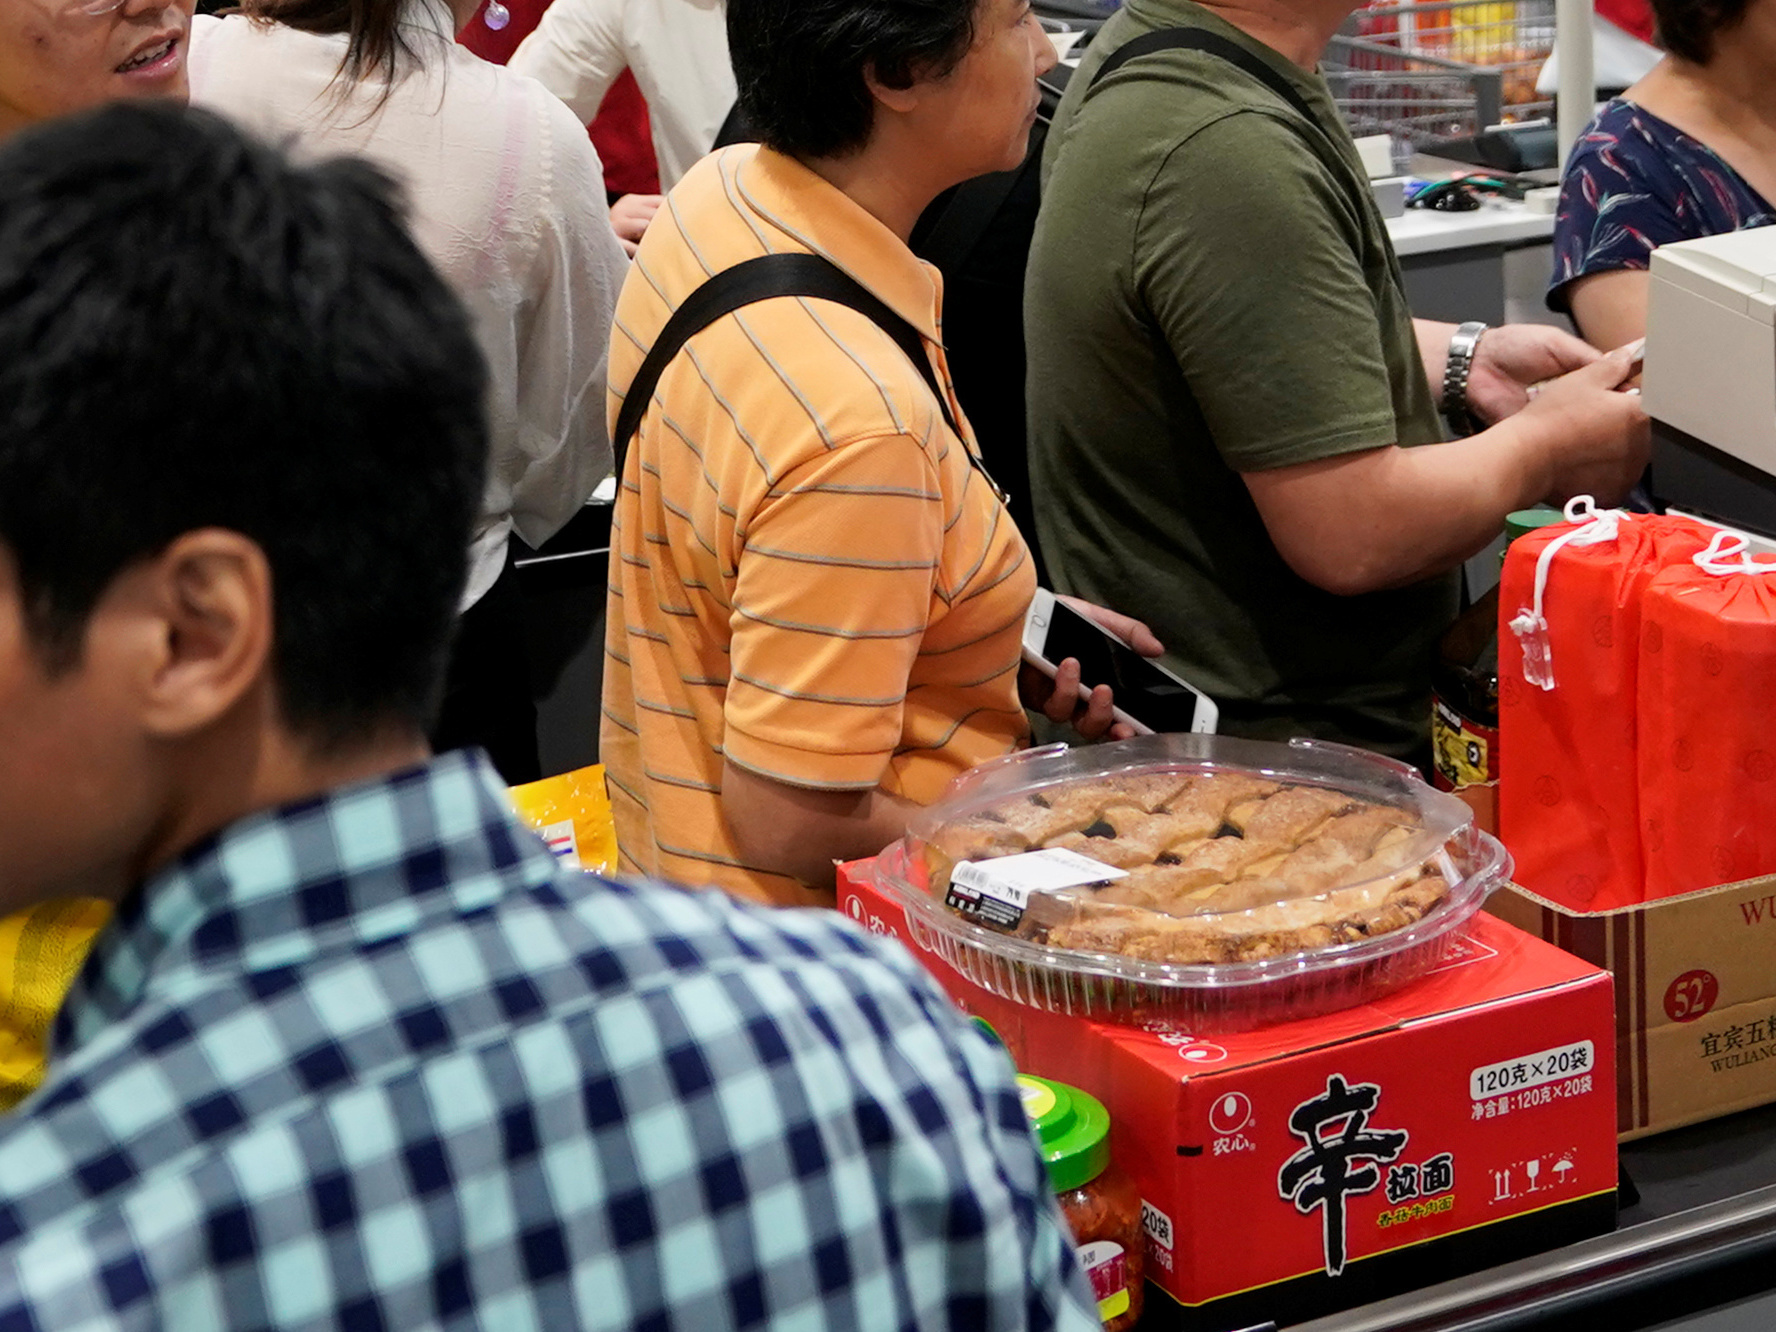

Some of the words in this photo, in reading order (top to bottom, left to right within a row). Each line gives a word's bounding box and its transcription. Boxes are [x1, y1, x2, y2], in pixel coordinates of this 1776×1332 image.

[1477, 1047, 1588, 1094] 120克×20袋
[1212, 1133, 1250, 1156] 农心
[1278, 1073, 1410, 1277] 辛
[1385, 1152, 1454, 1205] 拉面
[1377, 1195, 1454, 1228] 香菇牛肉面
